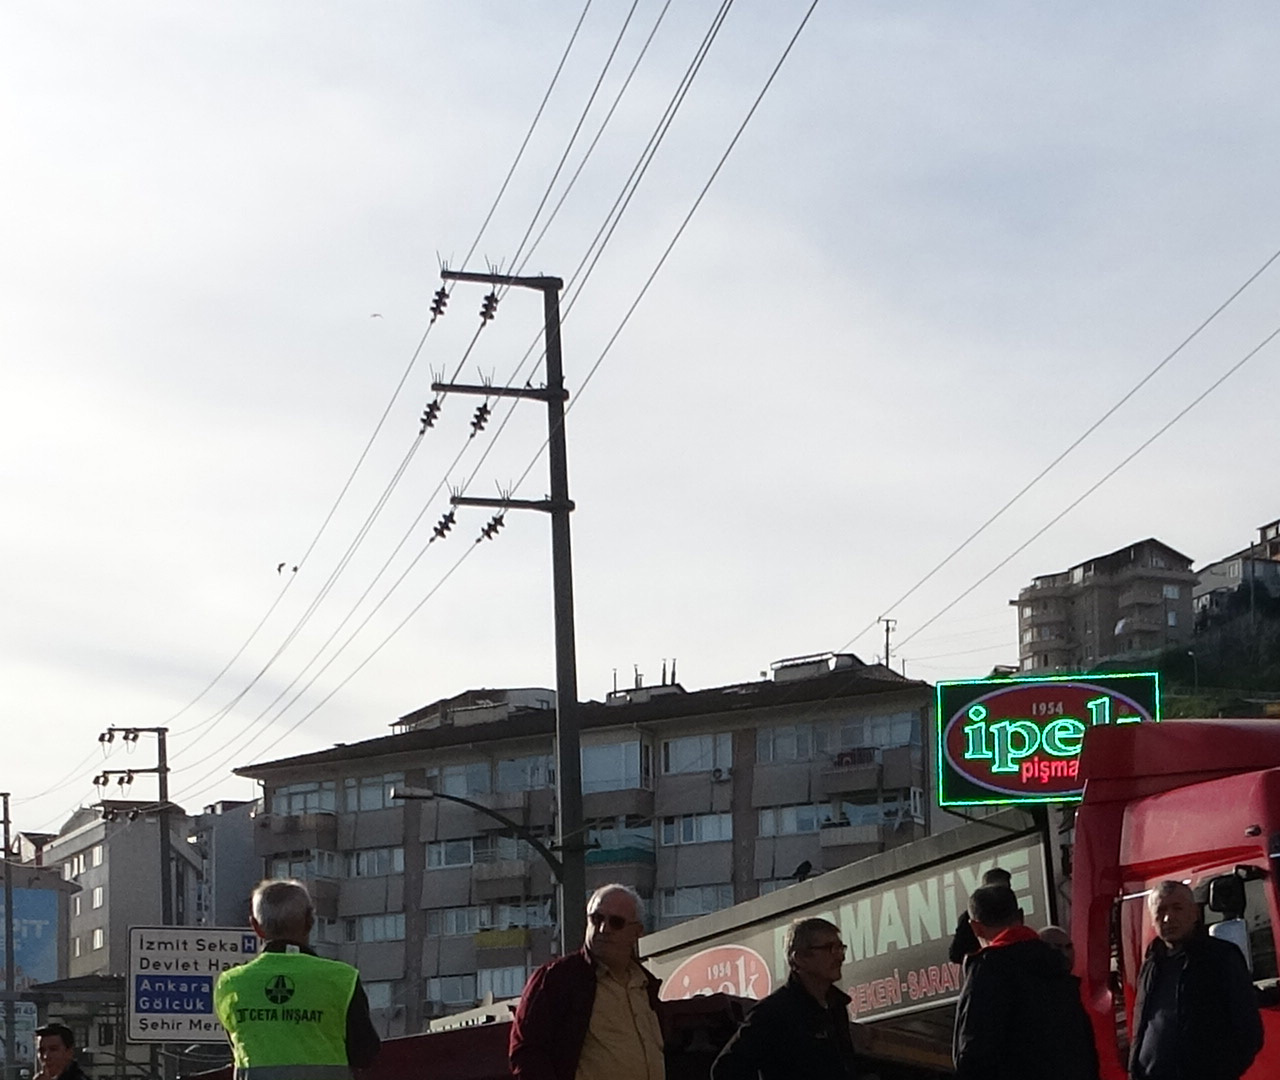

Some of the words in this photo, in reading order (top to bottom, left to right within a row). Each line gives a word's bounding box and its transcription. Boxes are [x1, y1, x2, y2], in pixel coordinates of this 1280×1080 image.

[1031, 701, 1064, 716] 1954
[139, 934, 188, 951] İzmit
[196, 938, 239, 952] Seka
[140, 957, 199, 971] Devlet
[209, 959, 249, 971] Ha
[707, 960, 732, 980] 1954
[140, 978, 210, 992] Ankara
[139, 996, 205, 1011] Gölcük
[249, 1008, 279, 1022] CETA
[281, 1006, 324, 1025] İNŞAAT
[138, 1018, 182, 1032] Şehir
